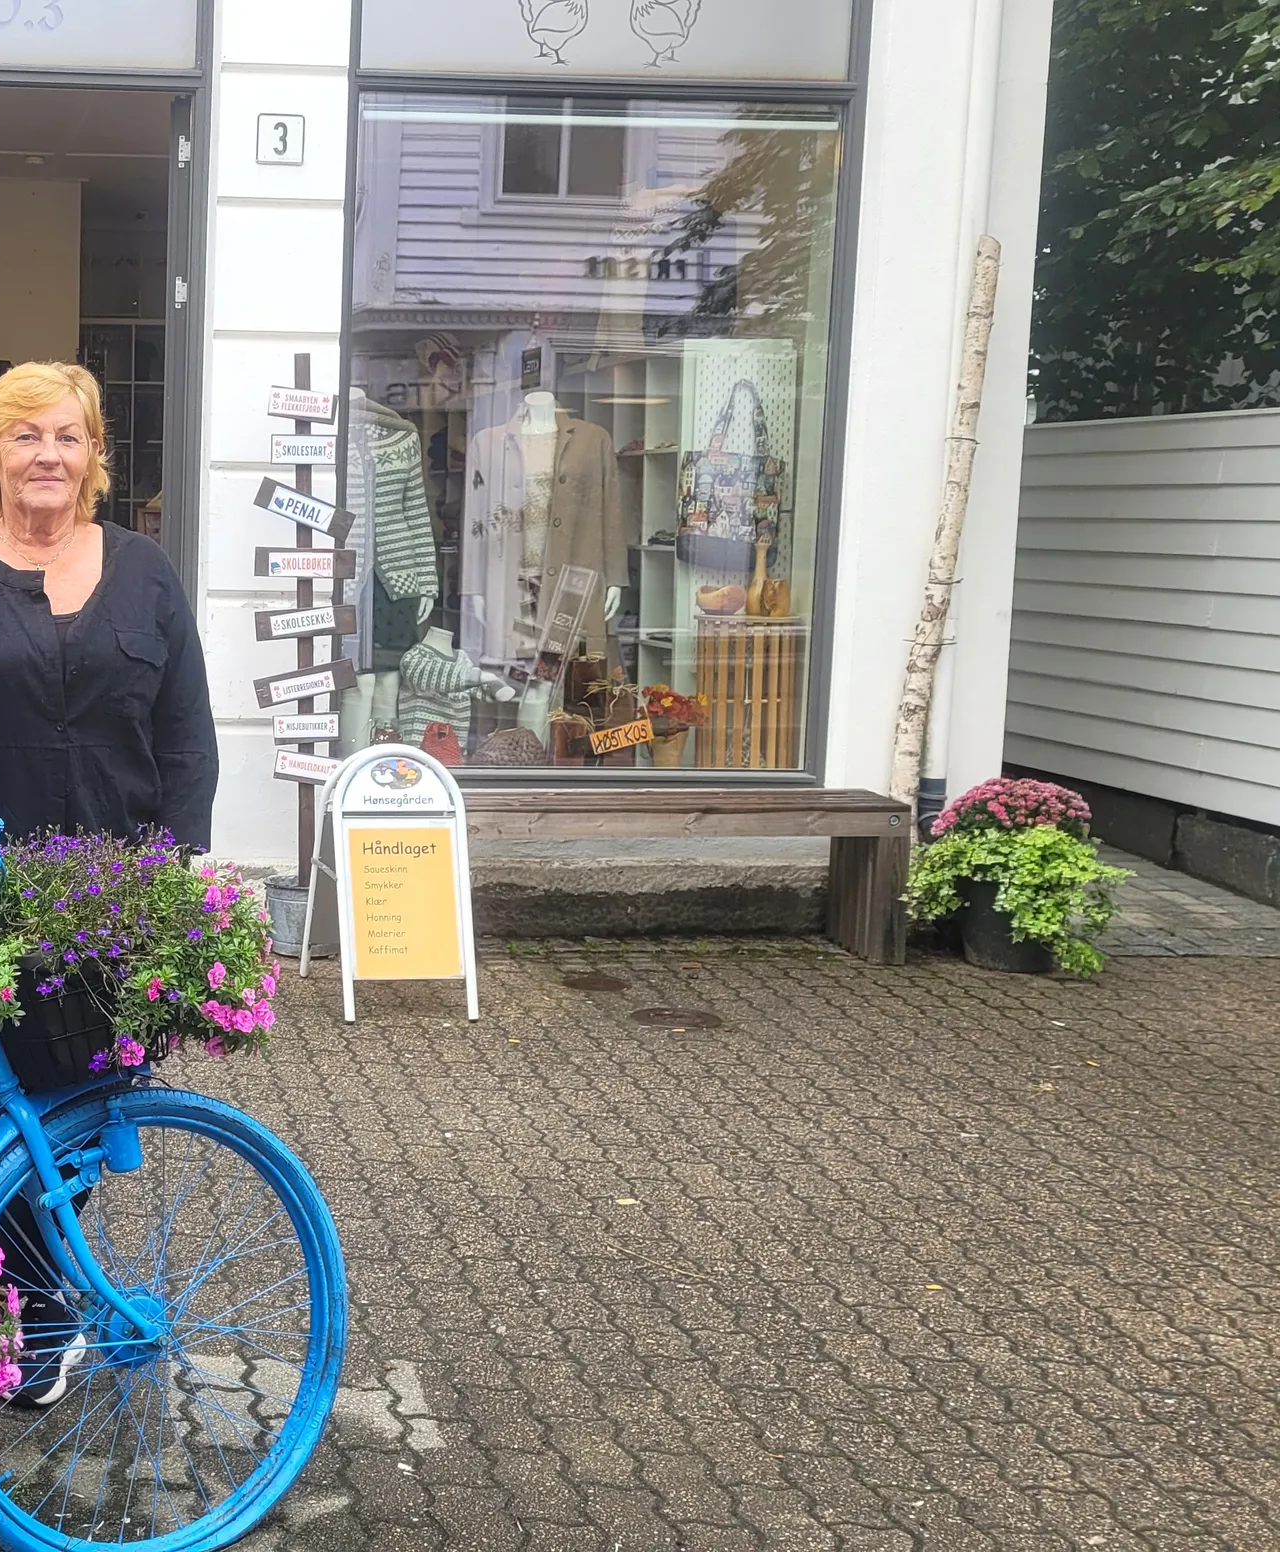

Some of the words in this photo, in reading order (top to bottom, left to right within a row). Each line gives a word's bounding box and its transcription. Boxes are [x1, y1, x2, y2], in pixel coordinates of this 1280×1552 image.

[273, 122, 288, 156] 3
[285, 394, 318, 404] SMAABYEN
[281, 402, 321, 413] FLEKKEFJORD
[282, 445, 327, 456] SKOLESTART
[285, 498, 322, 524] PENAL
[282, 558, 331, 571] SKOLEBØKER
[281, 613, 327, 630] SKOLESEKK
[282, 680, 324, 695] LISTERREGIONEN
[286, 722, 328, 731] NISJEBUTIKKER
[289, 760, 330, 774] HANDLELOKALT
[363, 793, 434, 807] Hønsegården
[362, 840, 437, 858] Håndlaget
[364, 865, 408, 874] Saueskinn
[365, 881, 403, 890] Smykker
[366, 897, 387, 905] Klær
[367, 913, 401, 924] Honning
[368, 929, 405, 937] Malerier
[369, 945, 408, 954] Kaffimat
